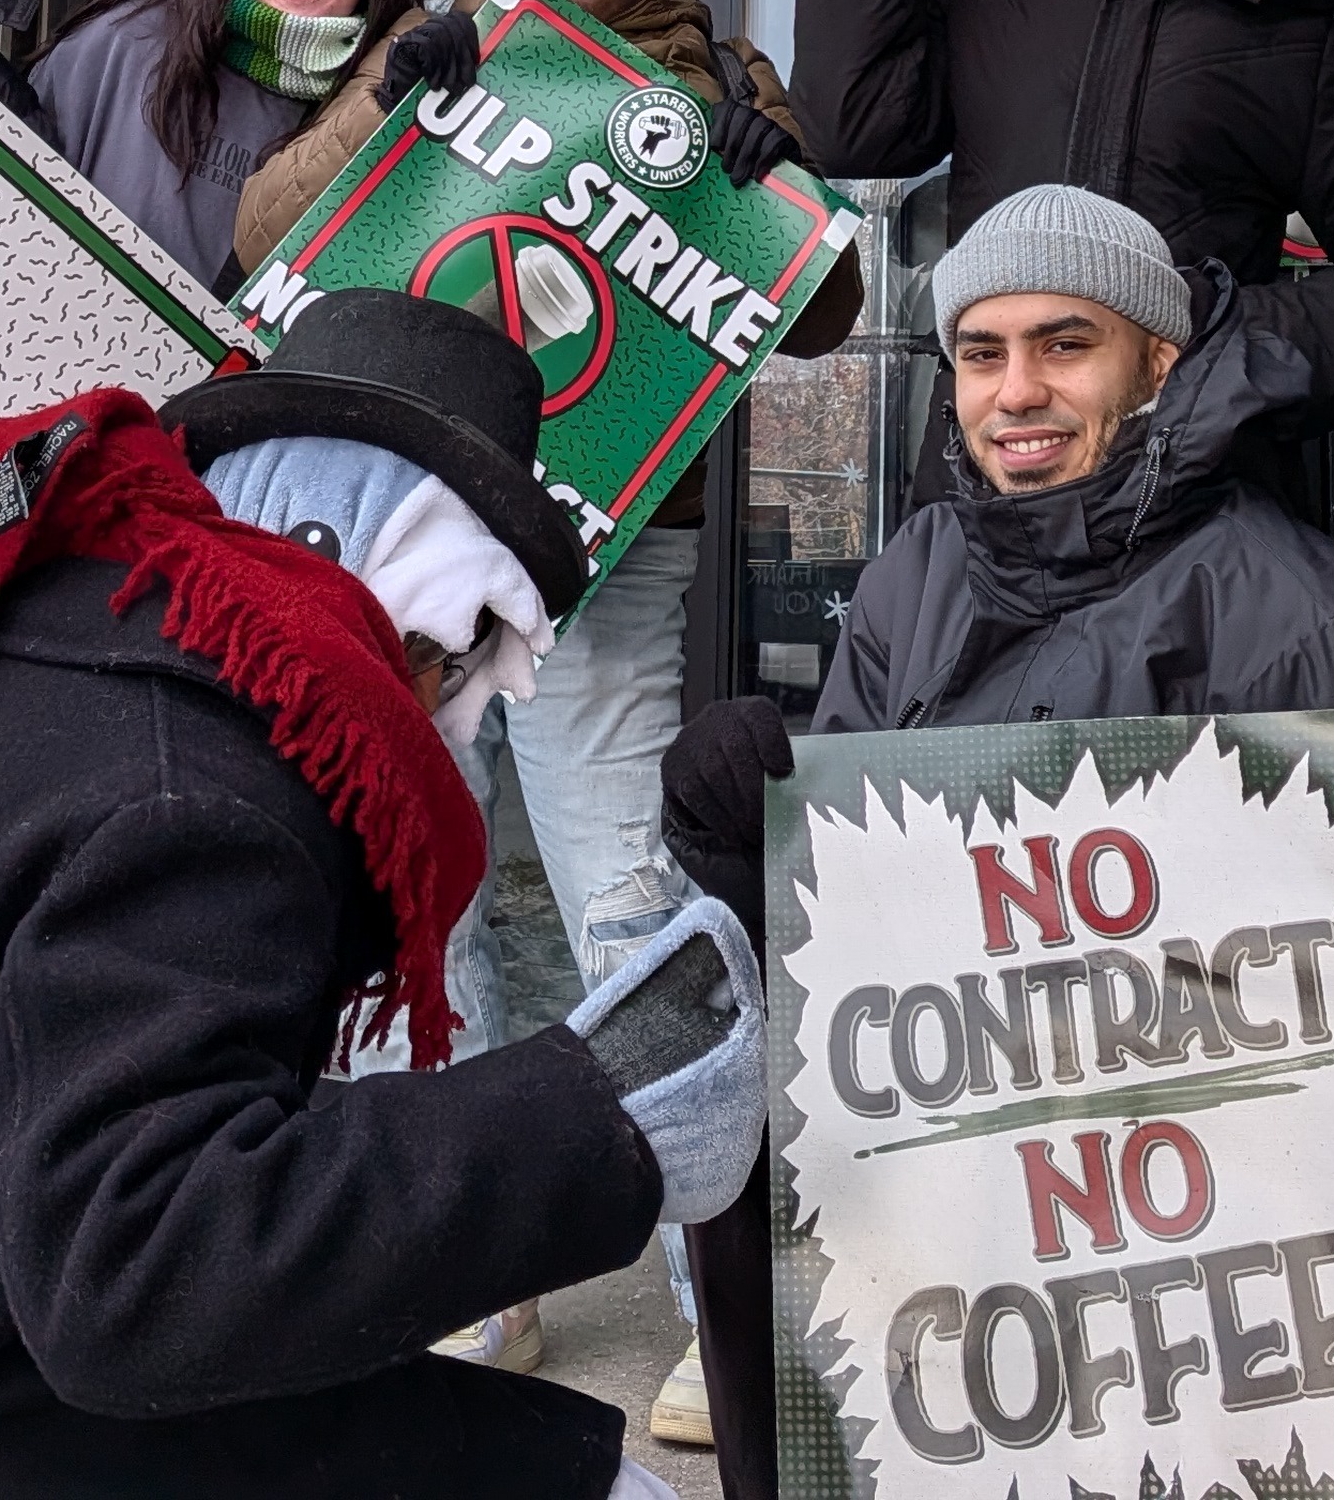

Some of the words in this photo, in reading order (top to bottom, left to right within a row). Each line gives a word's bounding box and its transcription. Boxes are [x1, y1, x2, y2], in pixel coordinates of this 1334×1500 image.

[614, 111, 638, 169] WORKERS
[643, 94, 703, 146] STARBUCKS
[650, 160, 693, 181] UNITED
[416, 82, 552, 178] ULP
[540, 161, 781, 373] STRIKE
[36, 420, 77, 468] RACHEL
[967, 826, 1160, 956] NO
[1016, 1118, 1214, 1262] NO
